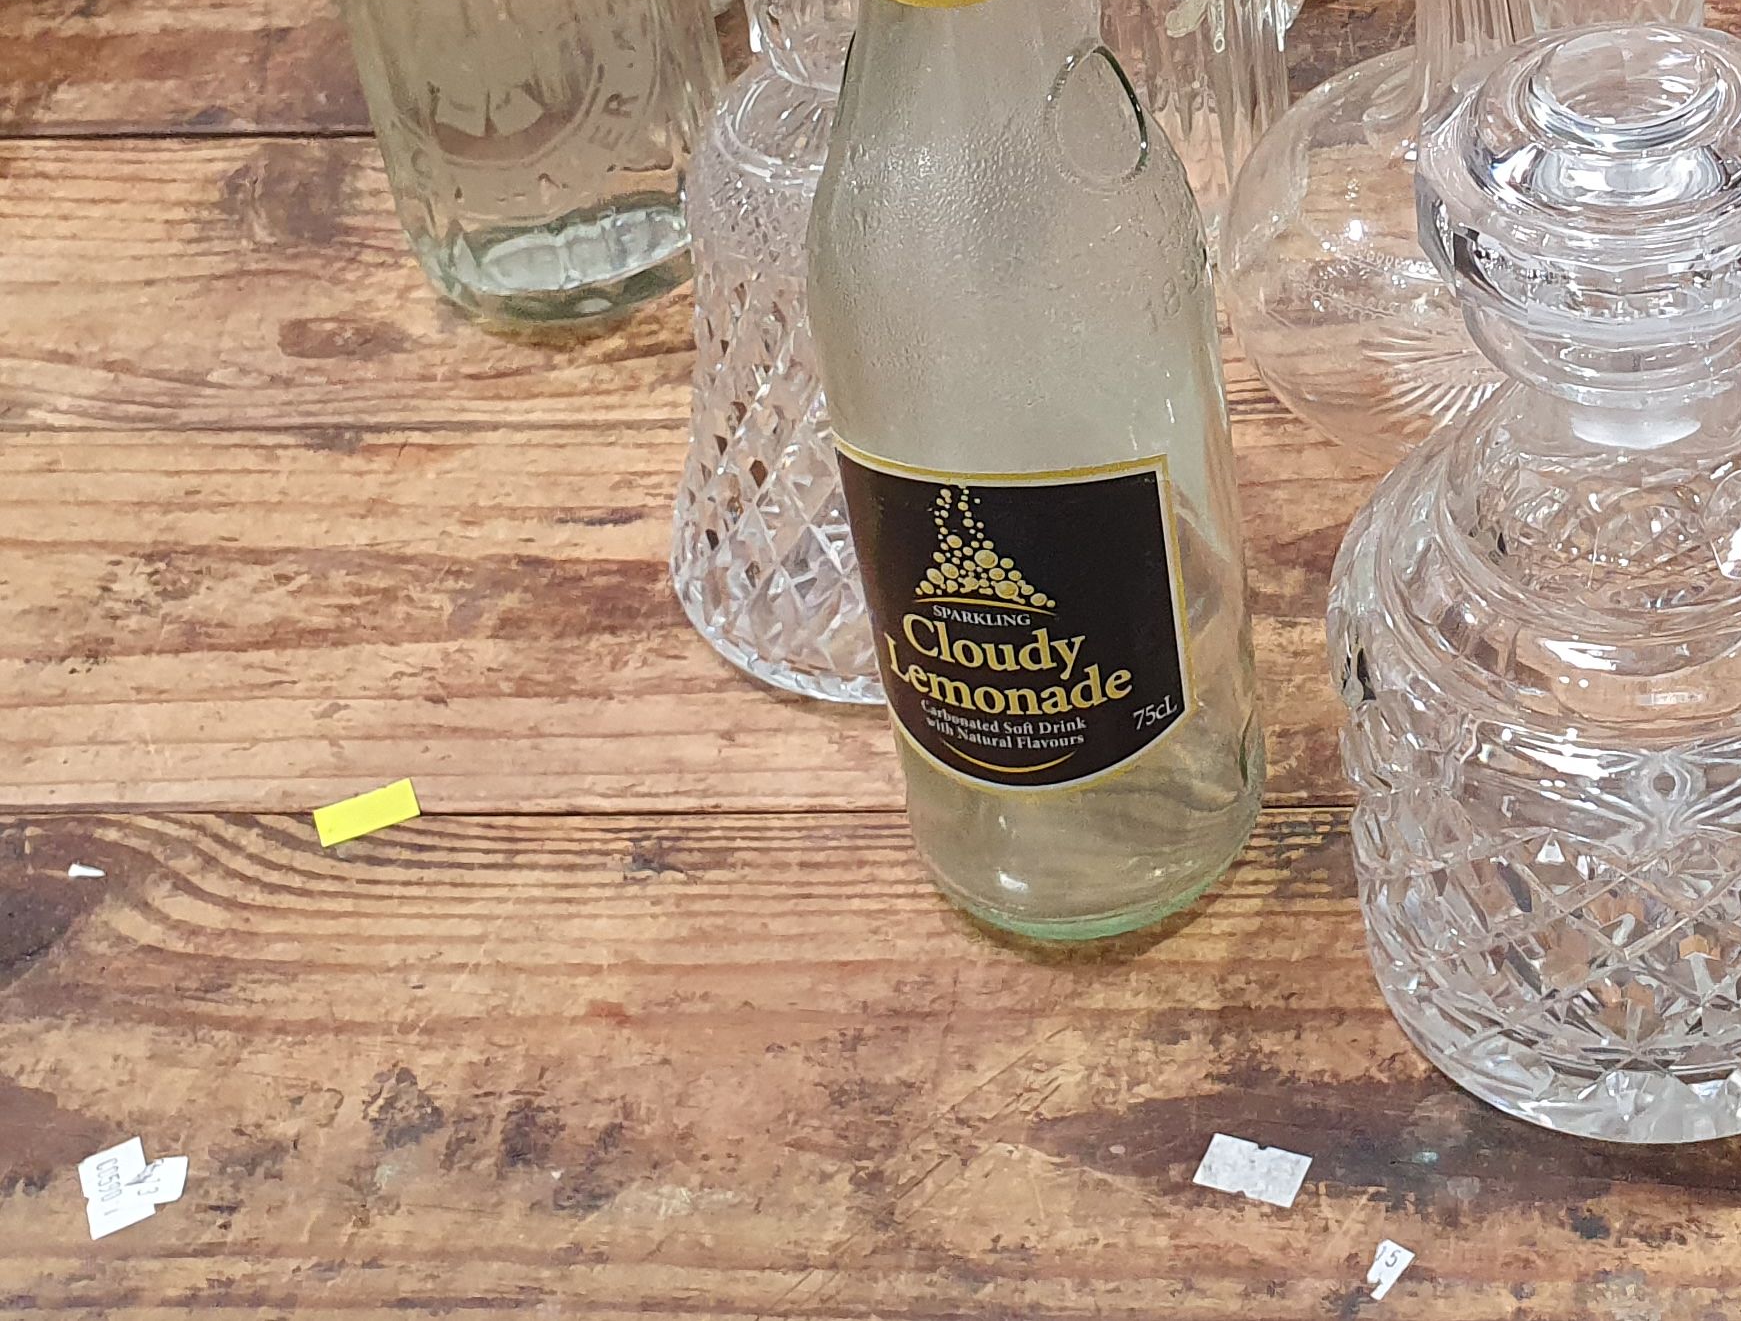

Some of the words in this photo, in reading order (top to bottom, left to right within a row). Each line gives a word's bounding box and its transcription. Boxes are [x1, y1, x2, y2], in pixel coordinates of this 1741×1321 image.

[933, 604, 1031, 626] SPARKLING
[903, 613, 1086, 680] Cloudy
[884, 632, 1132, 715] Lemonade
[920, 699, 1000, 733] Carbonated
[1003, 721, 1034, 735] Soft
[1038, 716, 1087, 735] Drink
[926, 716, 954, 737] with
[957, 727, 1013, 749] Natural
[1017, 734, 1084, 749] Flavours
